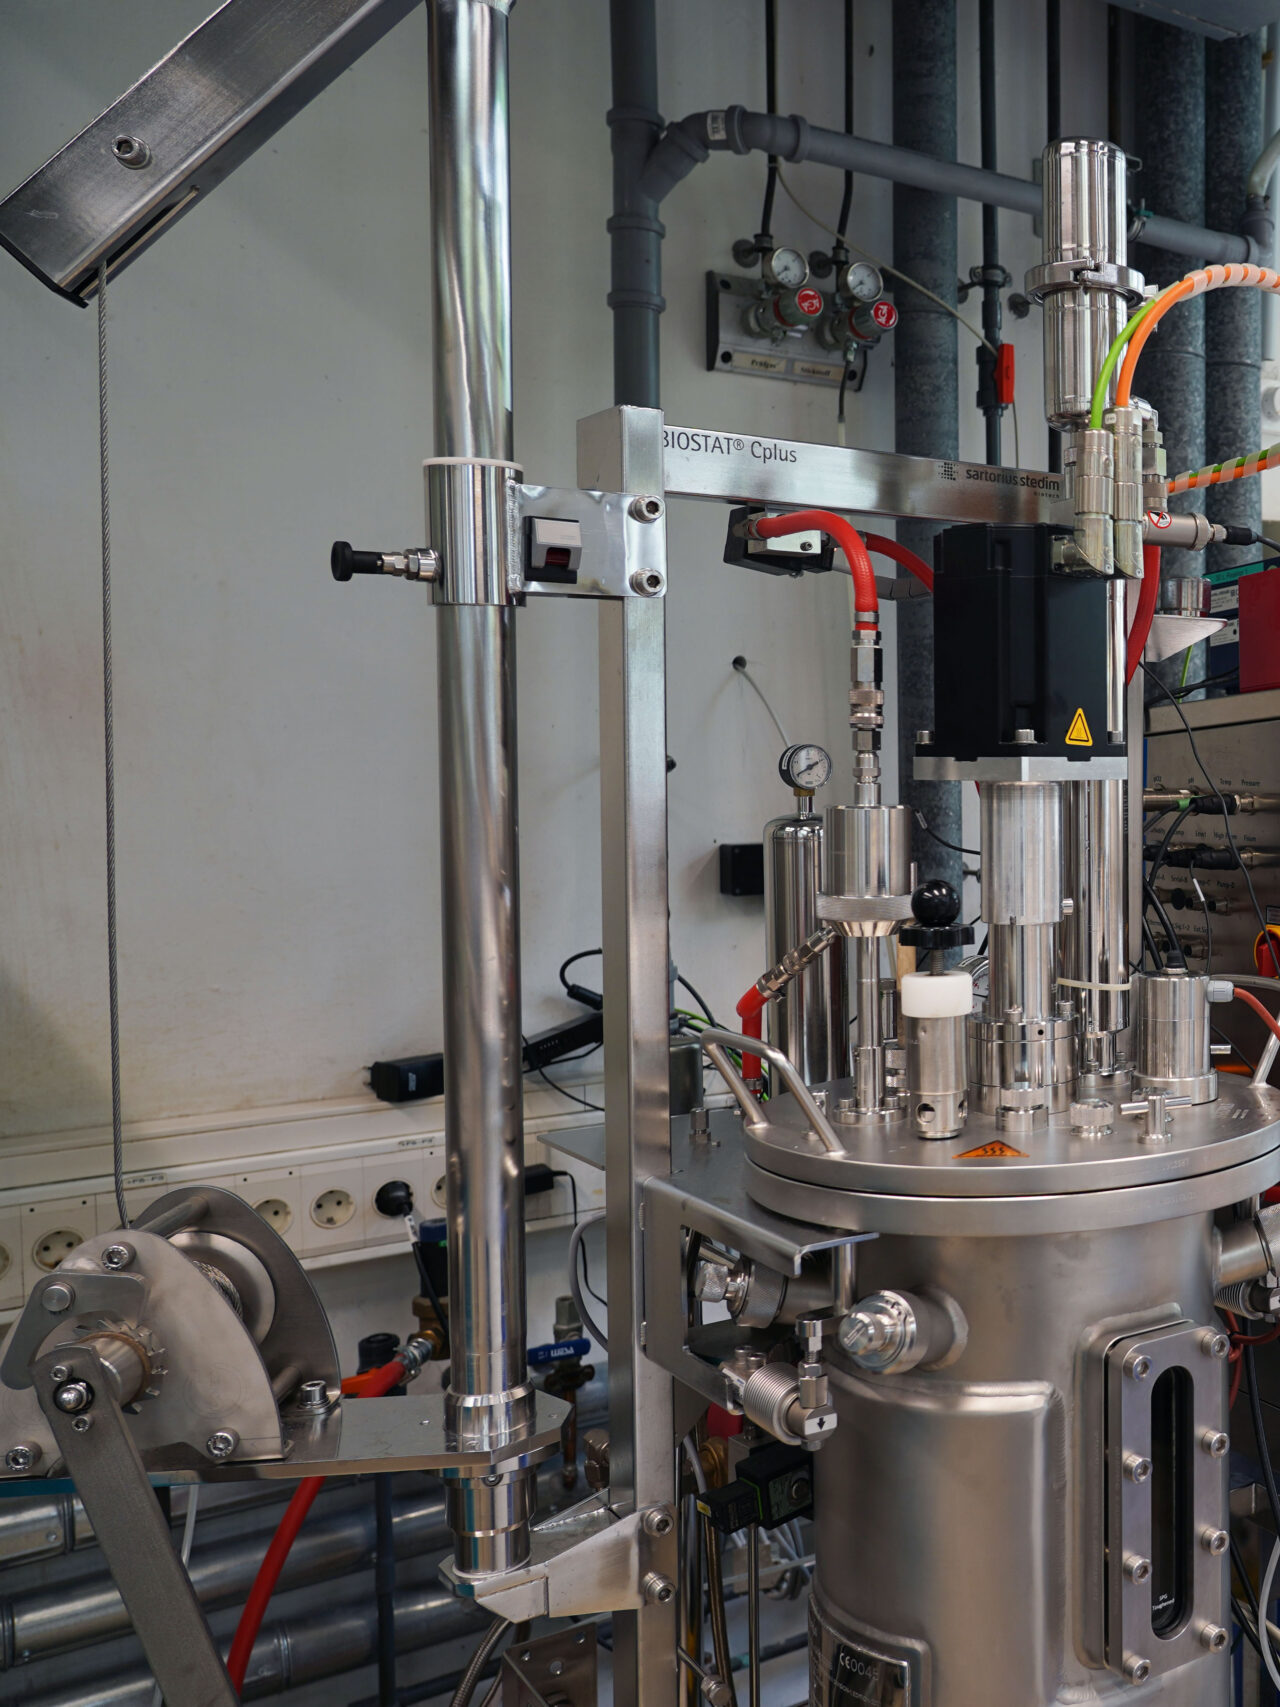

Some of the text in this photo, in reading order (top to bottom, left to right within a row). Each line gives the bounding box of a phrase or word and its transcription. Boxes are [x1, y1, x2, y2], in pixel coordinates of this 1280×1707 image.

[750, 440, 798, 464] Cplus
[965, 468, 1060, 492] sartorius stedim
